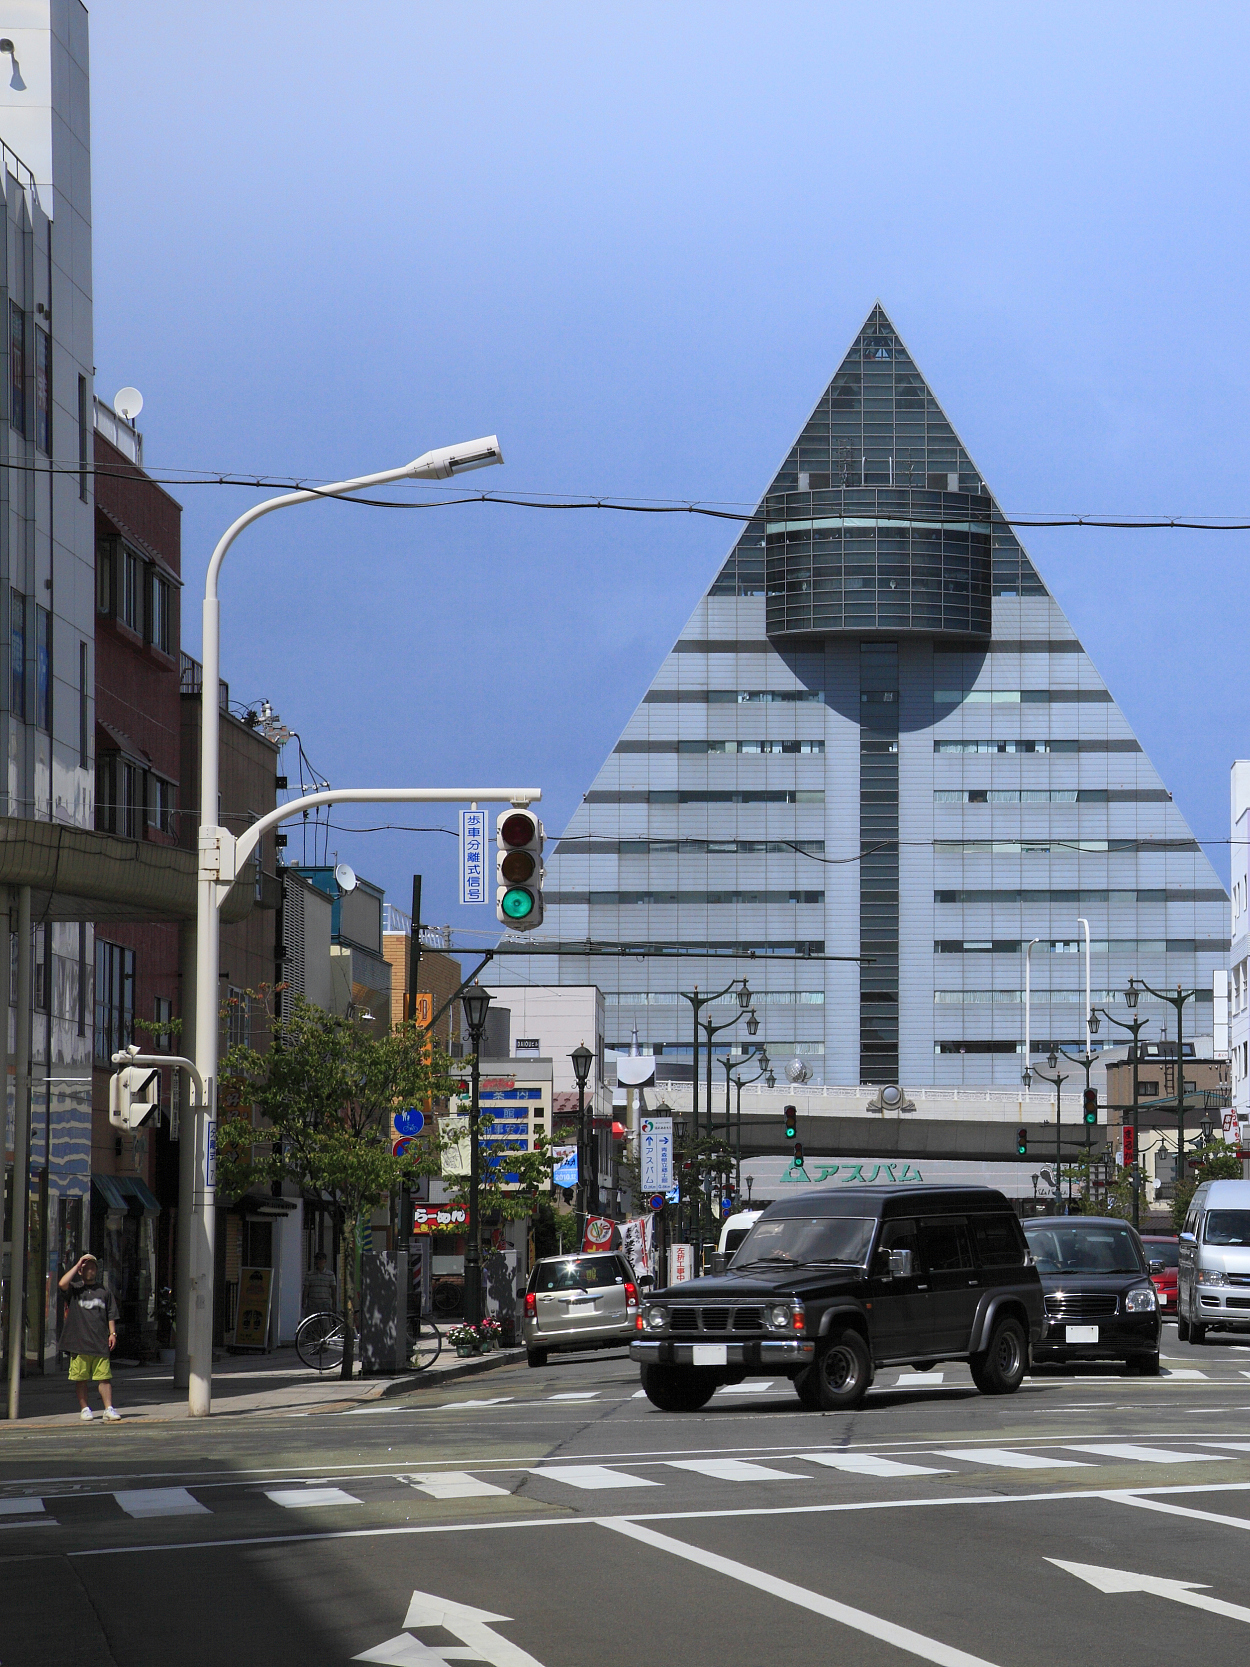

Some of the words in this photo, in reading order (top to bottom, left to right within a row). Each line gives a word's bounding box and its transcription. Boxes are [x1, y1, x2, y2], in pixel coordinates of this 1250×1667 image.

[466, 815, 481, 900] 歩車分離式信号
[813, 1164, 924, 1183] アスパム
[414, 1208, 466, 1224] らーめん
